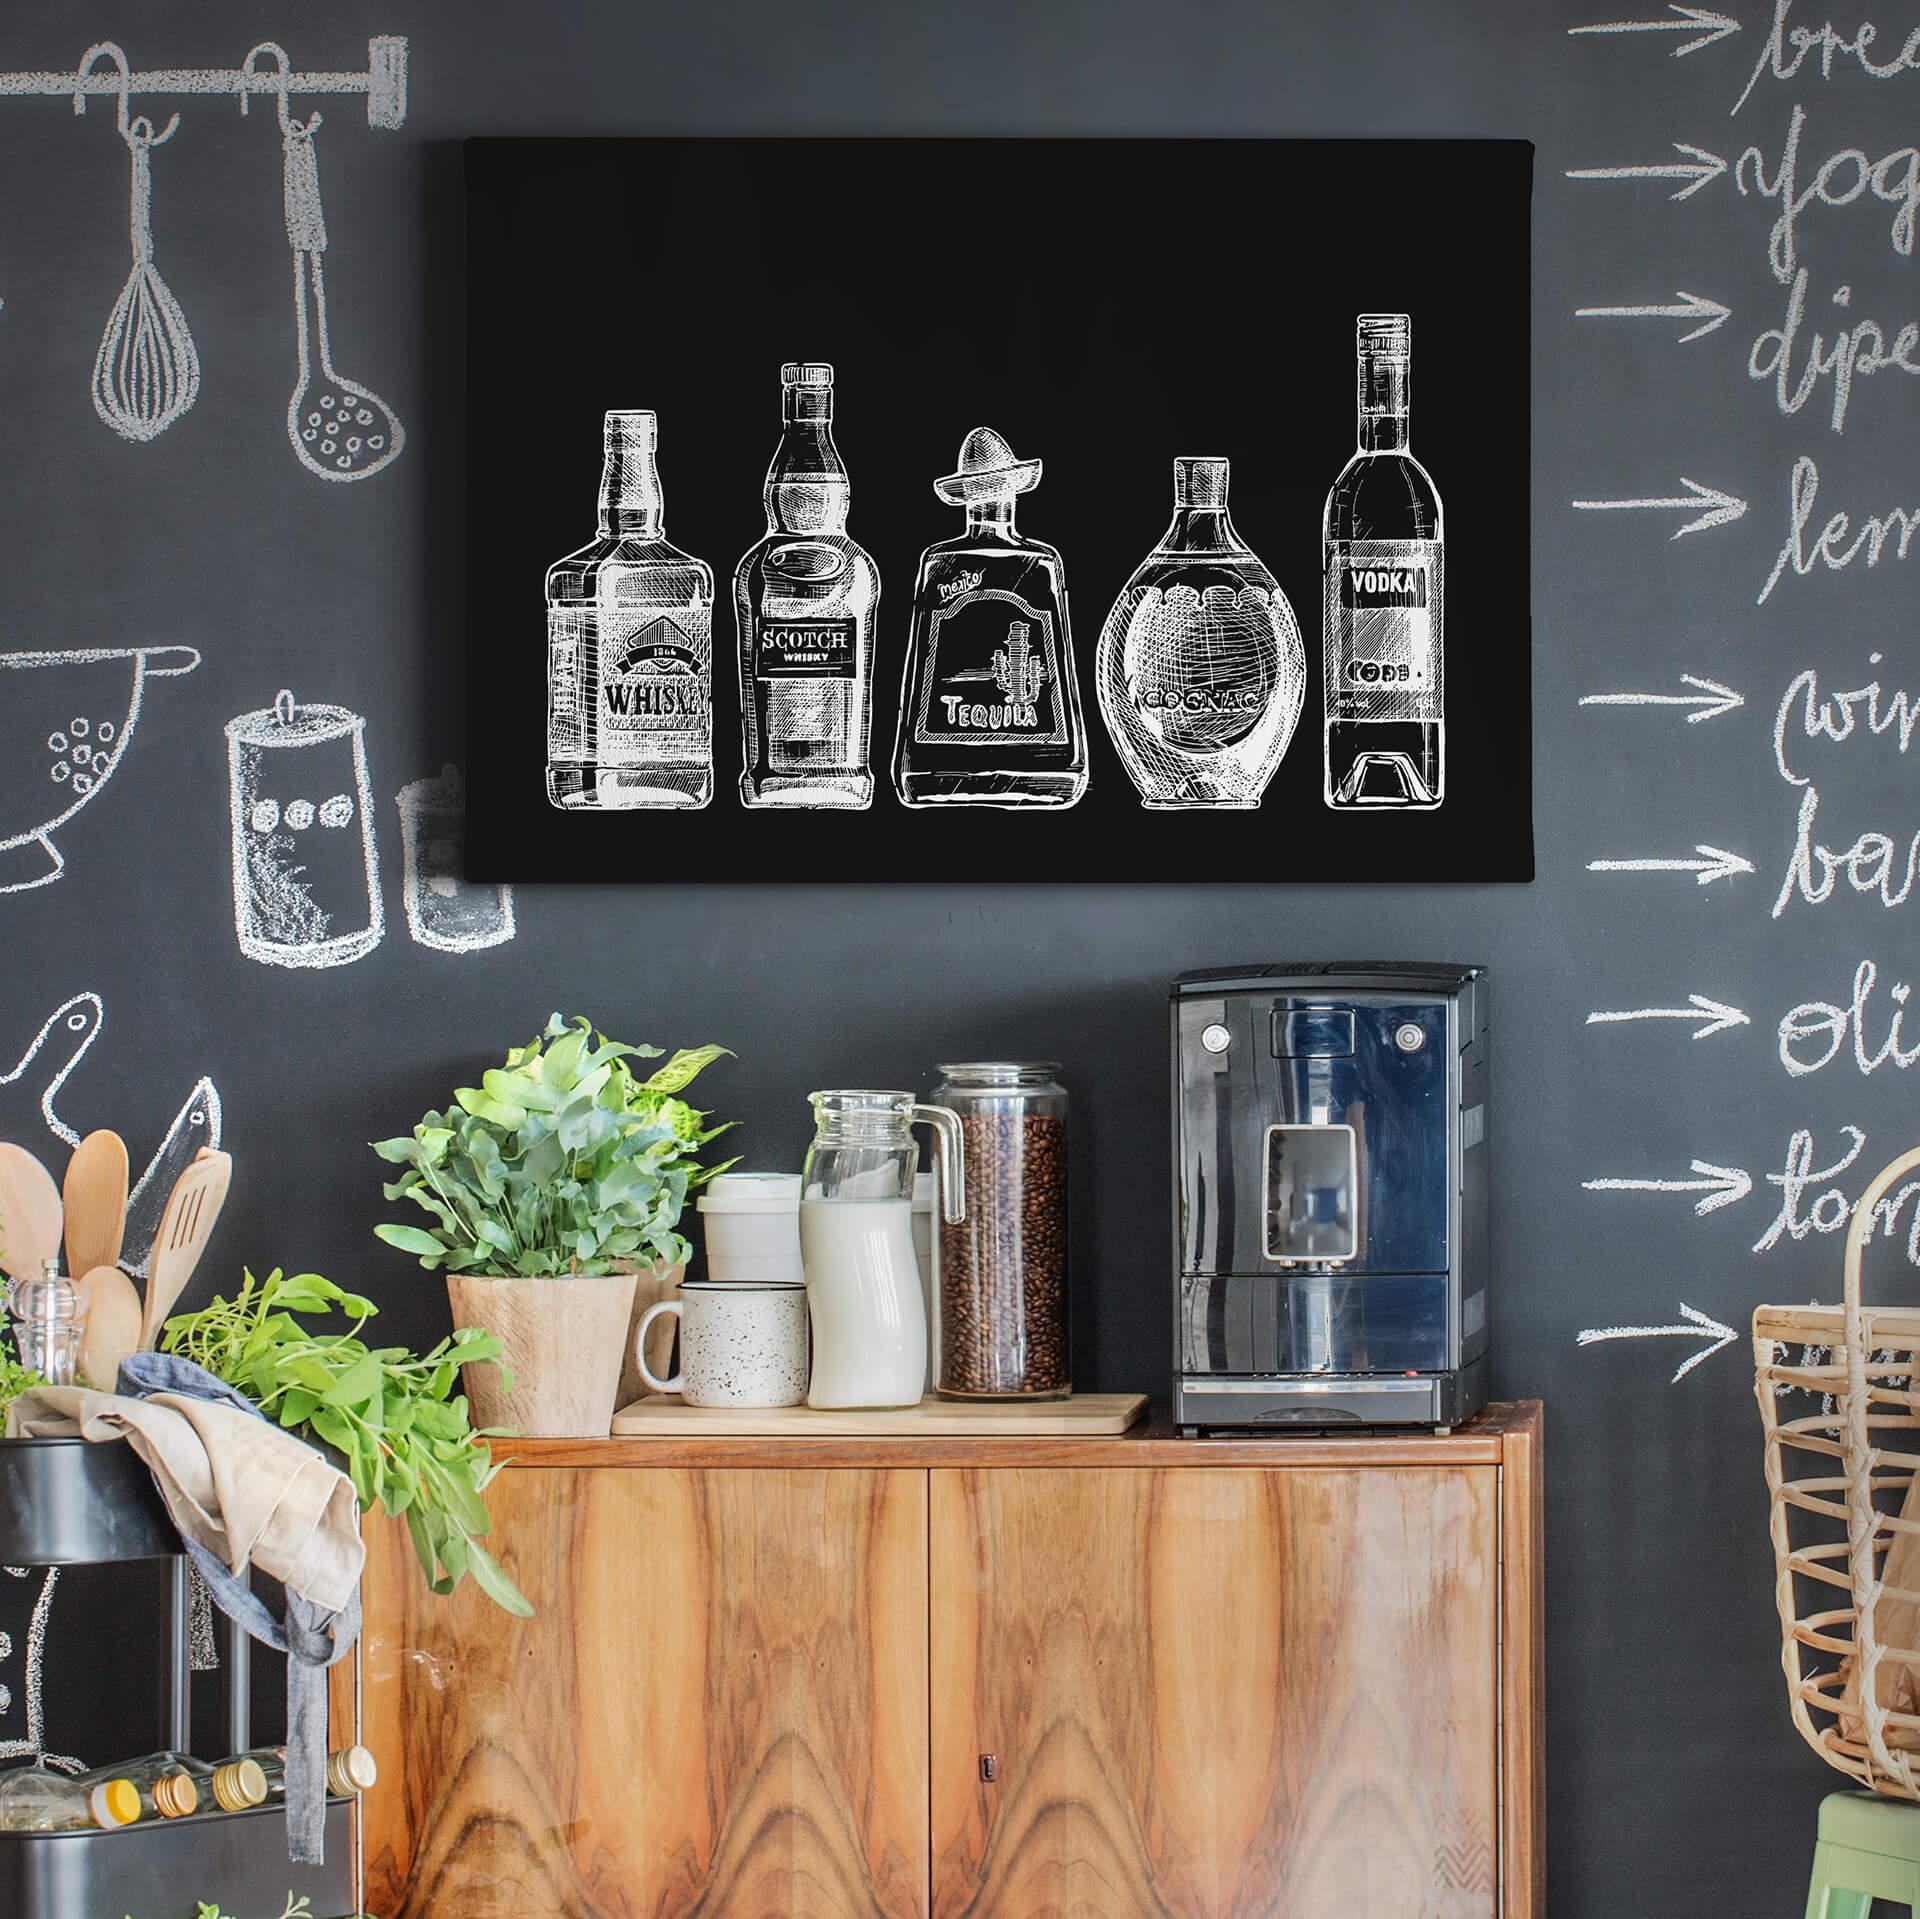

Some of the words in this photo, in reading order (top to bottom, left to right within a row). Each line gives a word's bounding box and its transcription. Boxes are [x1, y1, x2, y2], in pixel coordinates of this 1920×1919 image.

[1351, 571, 1416, 593] VODKA
[762, 628, 848, 652] SCOTCH
[784, 653, 829, 662] WHISKY
[604, 684, 708, 715] WHISKEY
[1143, 688, 1260, 712] COGNAC
[940, 696, 1038, 729] TEQUILA
